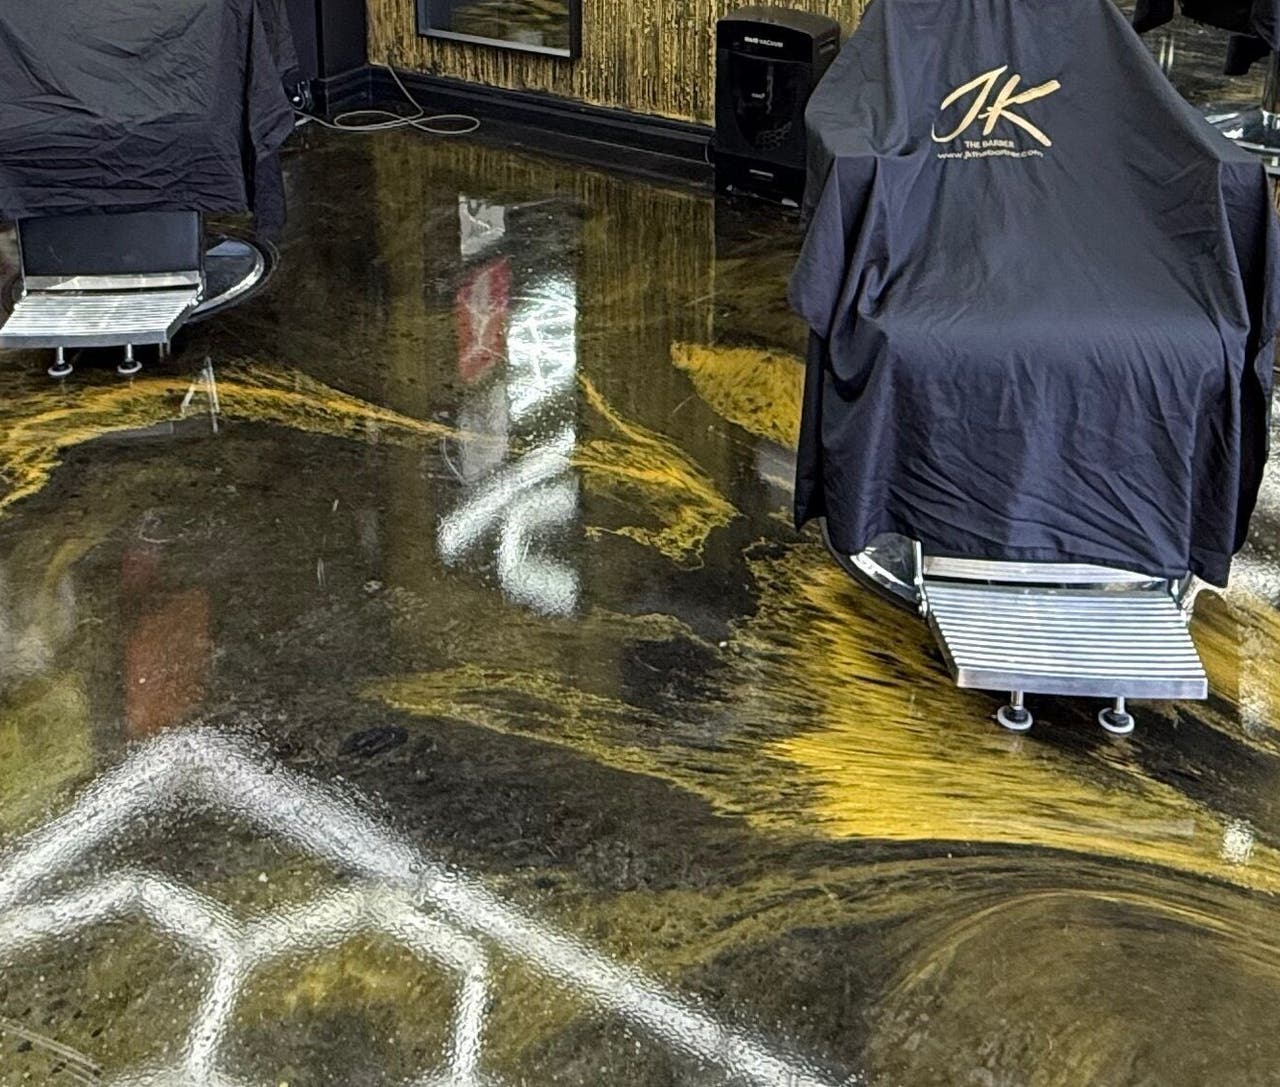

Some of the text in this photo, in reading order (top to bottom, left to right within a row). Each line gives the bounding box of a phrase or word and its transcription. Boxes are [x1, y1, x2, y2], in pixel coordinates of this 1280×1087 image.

[931, 64, 1062, 147] JK
[964, 139, 1014, 148] THE BARBER
